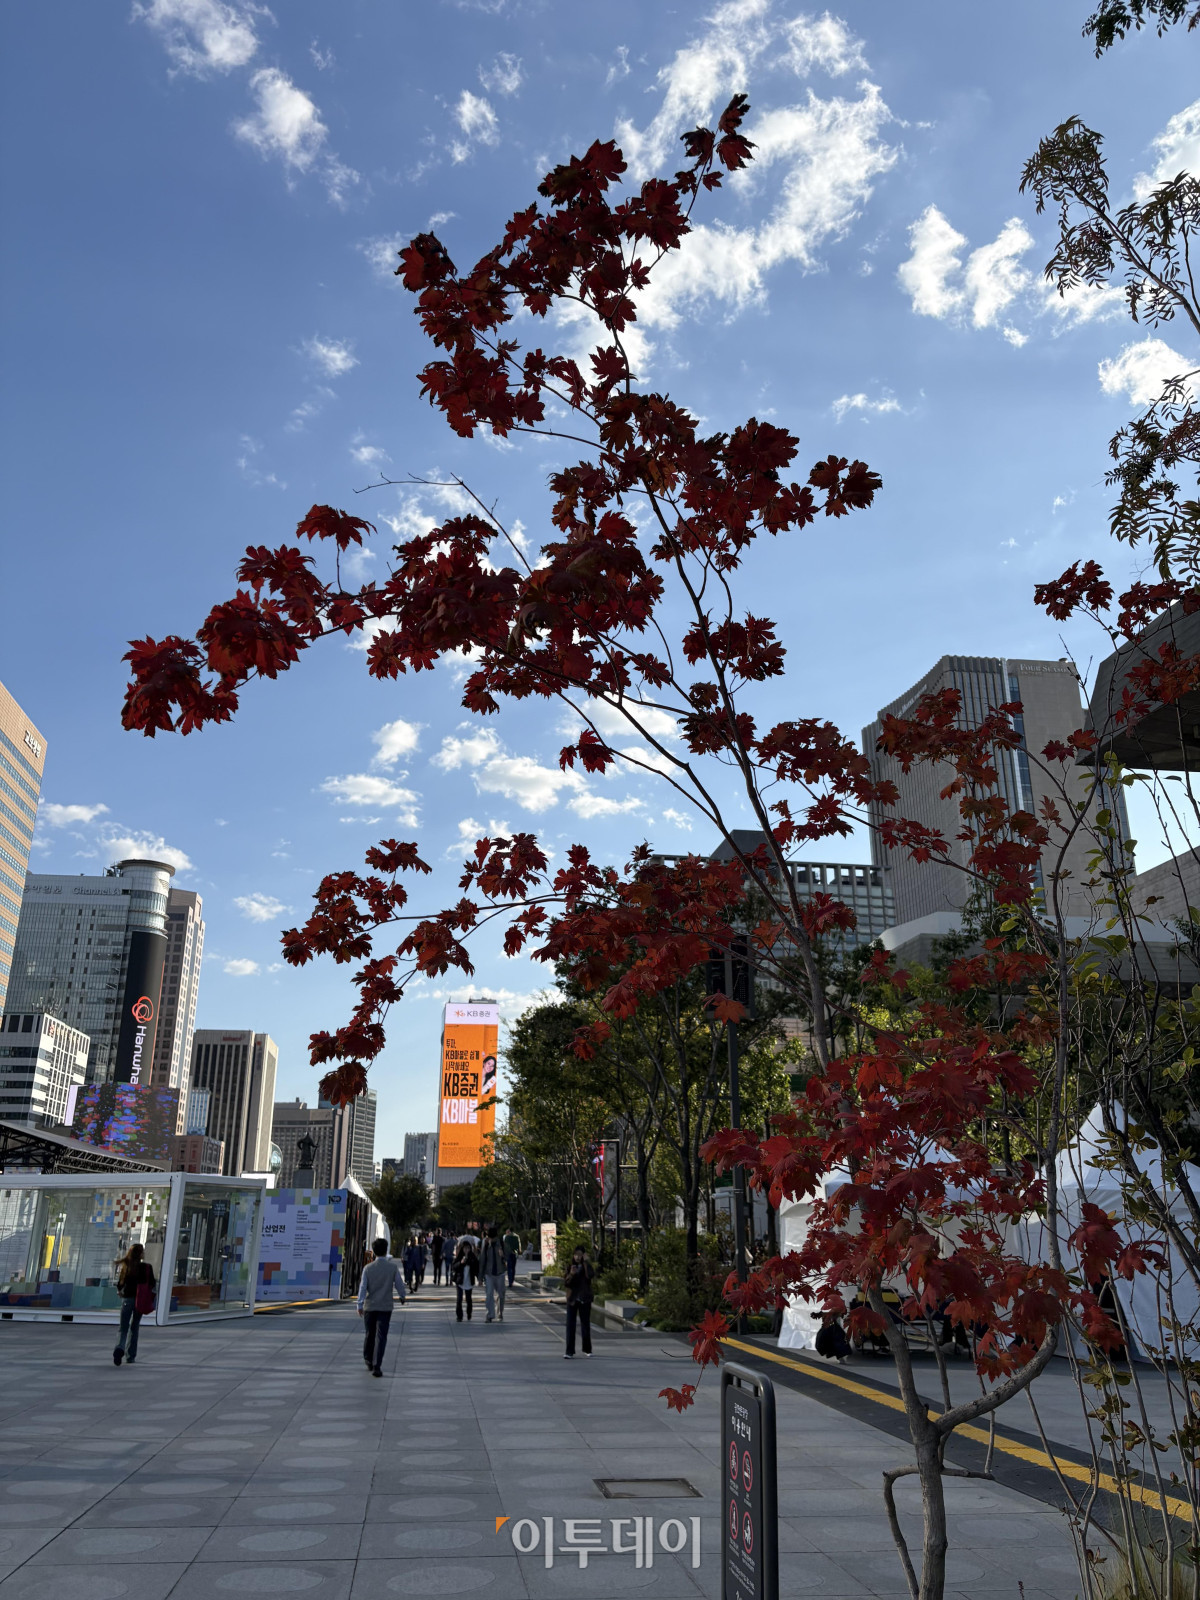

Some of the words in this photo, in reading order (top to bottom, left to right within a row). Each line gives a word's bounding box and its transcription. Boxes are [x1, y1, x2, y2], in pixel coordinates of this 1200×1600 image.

[1020, 663, 1041, 671] FOUR
[72, 887, 110, 895] Channel
[129, 1025, 147, 1085] Hanwha
[470, 1050, 480, 1060] 쉽게
[445, 1061, 469, 1072] 시작하세요
[443, 1073, 479, 1097] KB증권
[442, 1098, 479, 1124] KB마블
[262, 1224, 286, 1234] 산업전
